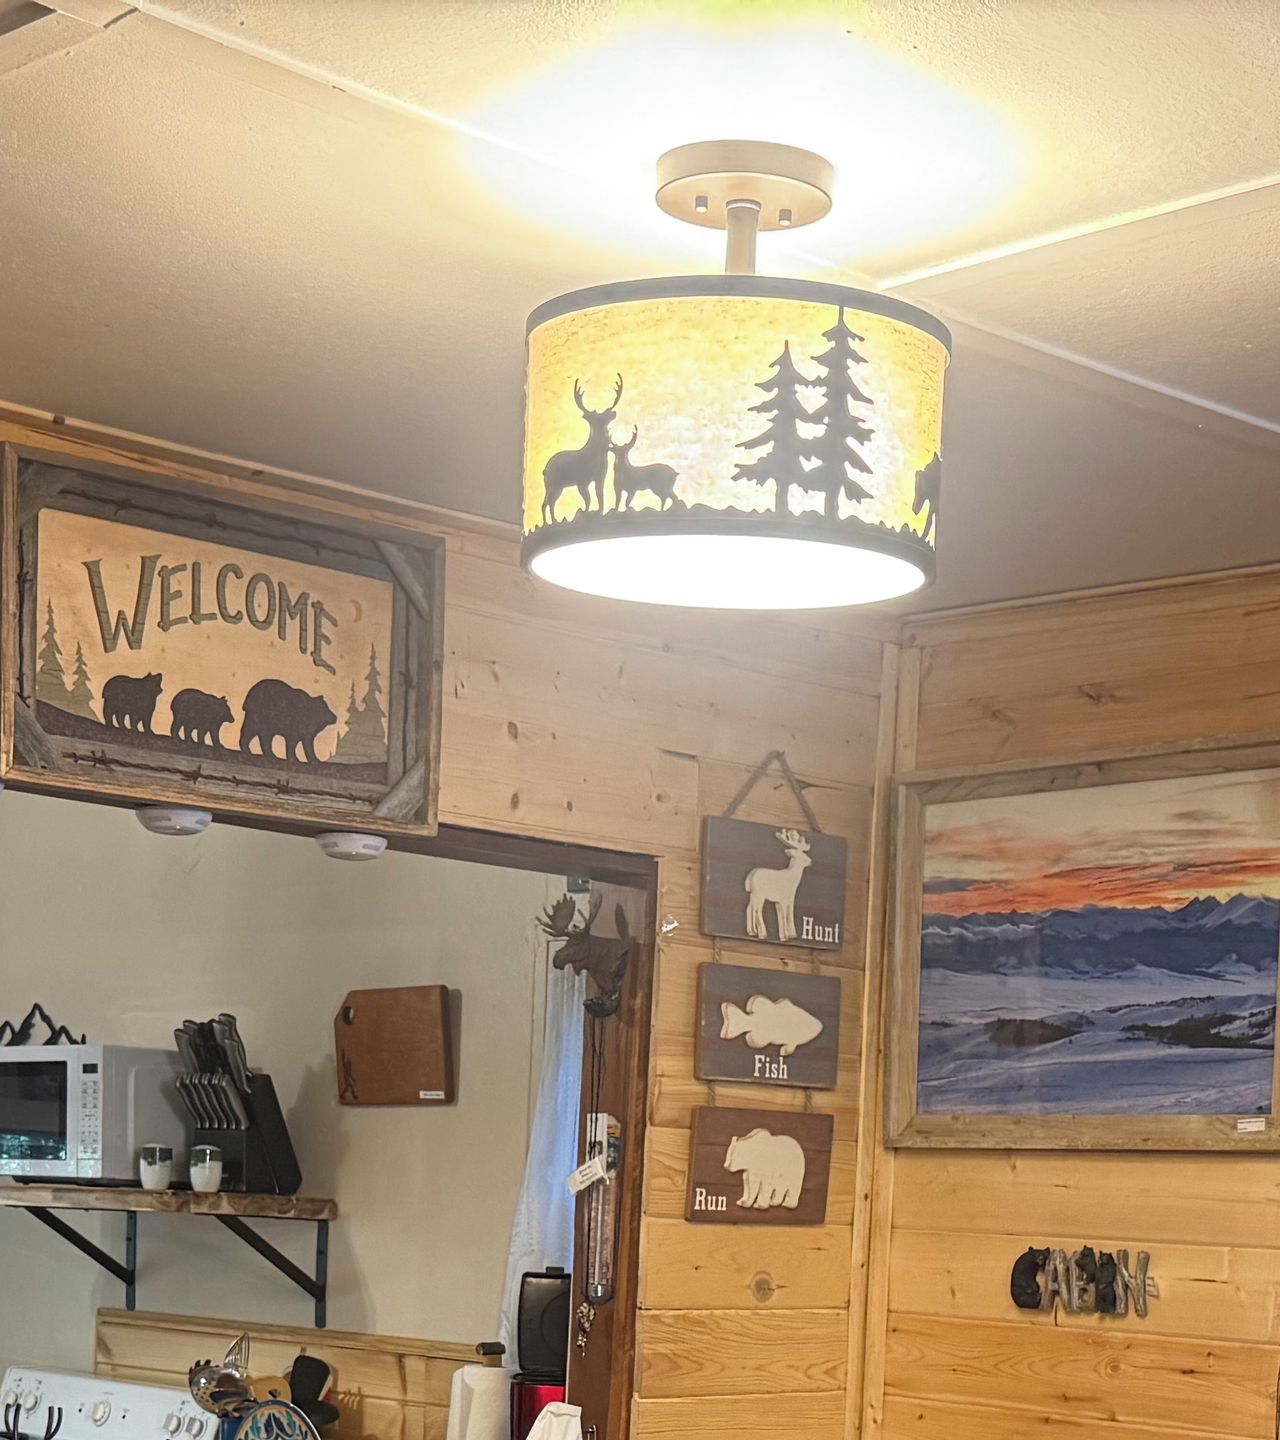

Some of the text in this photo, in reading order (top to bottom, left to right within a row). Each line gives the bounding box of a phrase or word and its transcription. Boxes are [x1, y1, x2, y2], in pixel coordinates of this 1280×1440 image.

[81, 553, 340, 676] WELCOME
[801, 916, 840, 944] Hunt
[753, 1054, 789, 1080] Fish
[693, 1187, 728, 1212] Run
